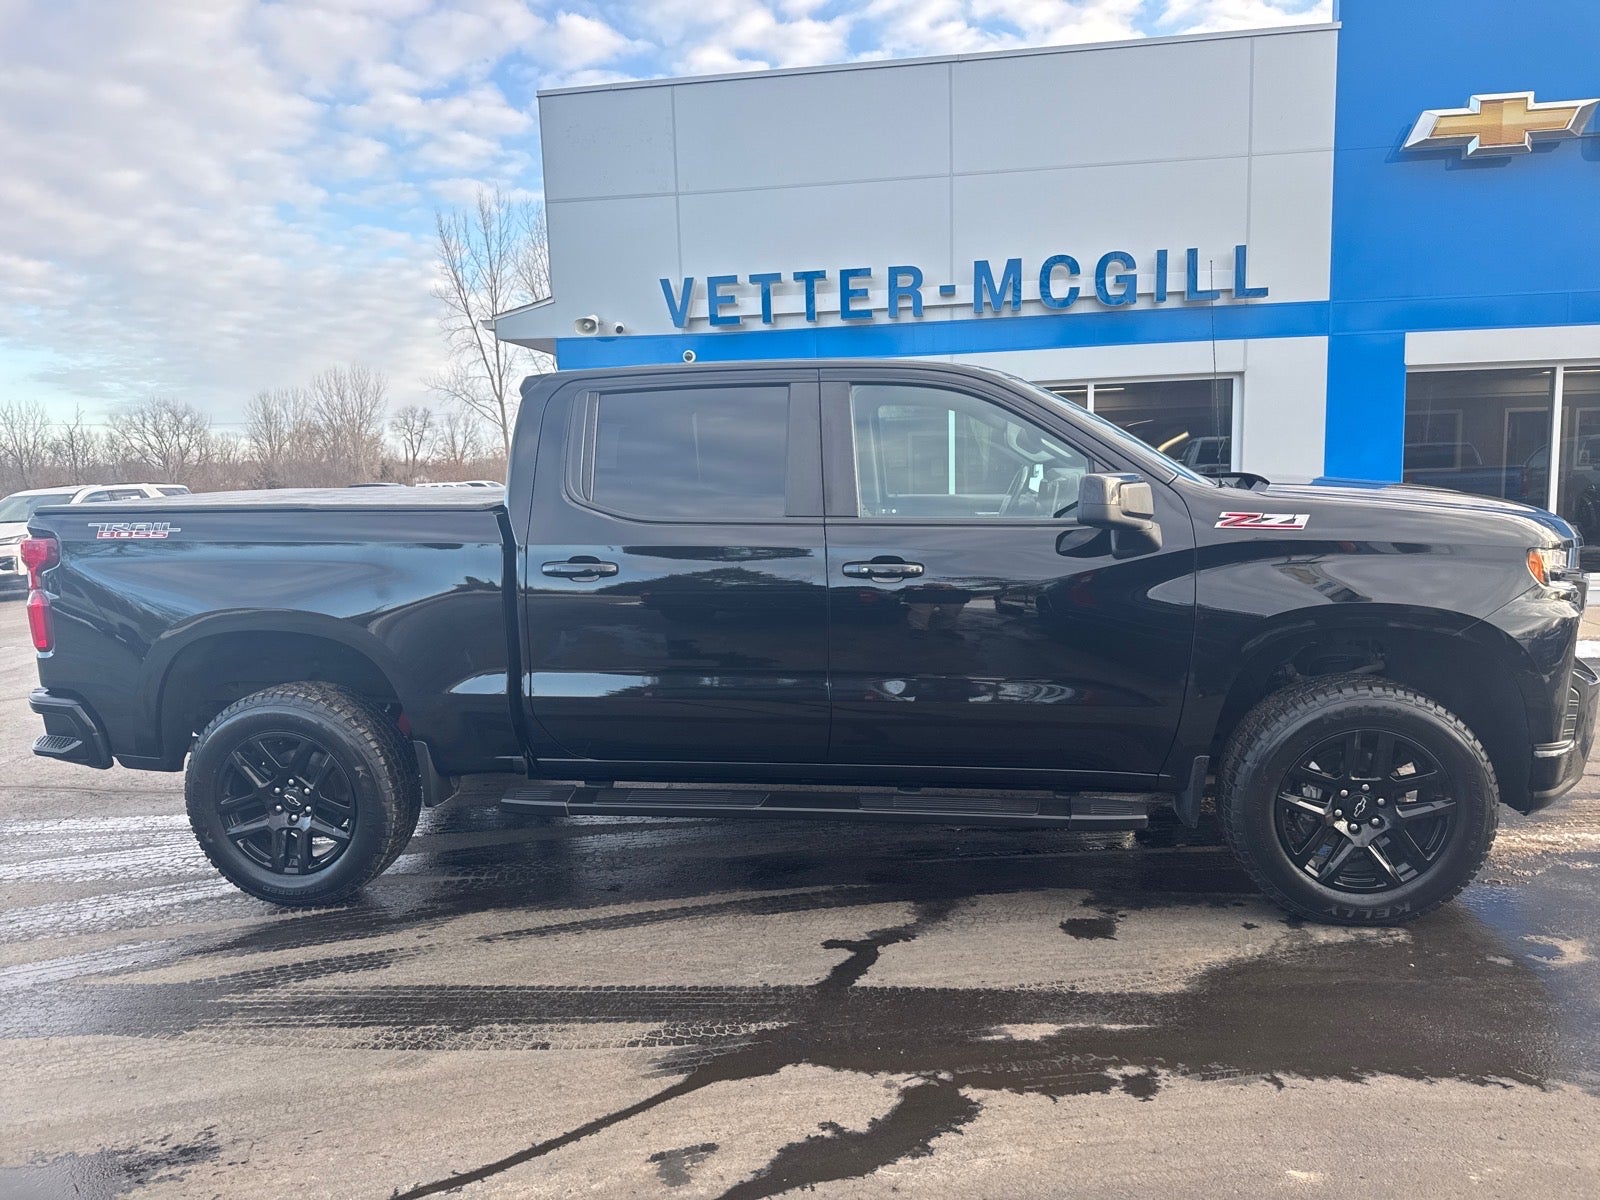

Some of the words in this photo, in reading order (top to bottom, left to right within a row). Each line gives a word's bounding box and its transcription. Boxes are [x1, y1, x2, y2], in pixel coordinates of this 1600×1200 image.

[88, 522, 181, 532] TRAIL
[1214, 511, 1311, 530] Z71
[97, 530, 169, 539] BOSS
[1323, 902, 1411, 919] KELLY
